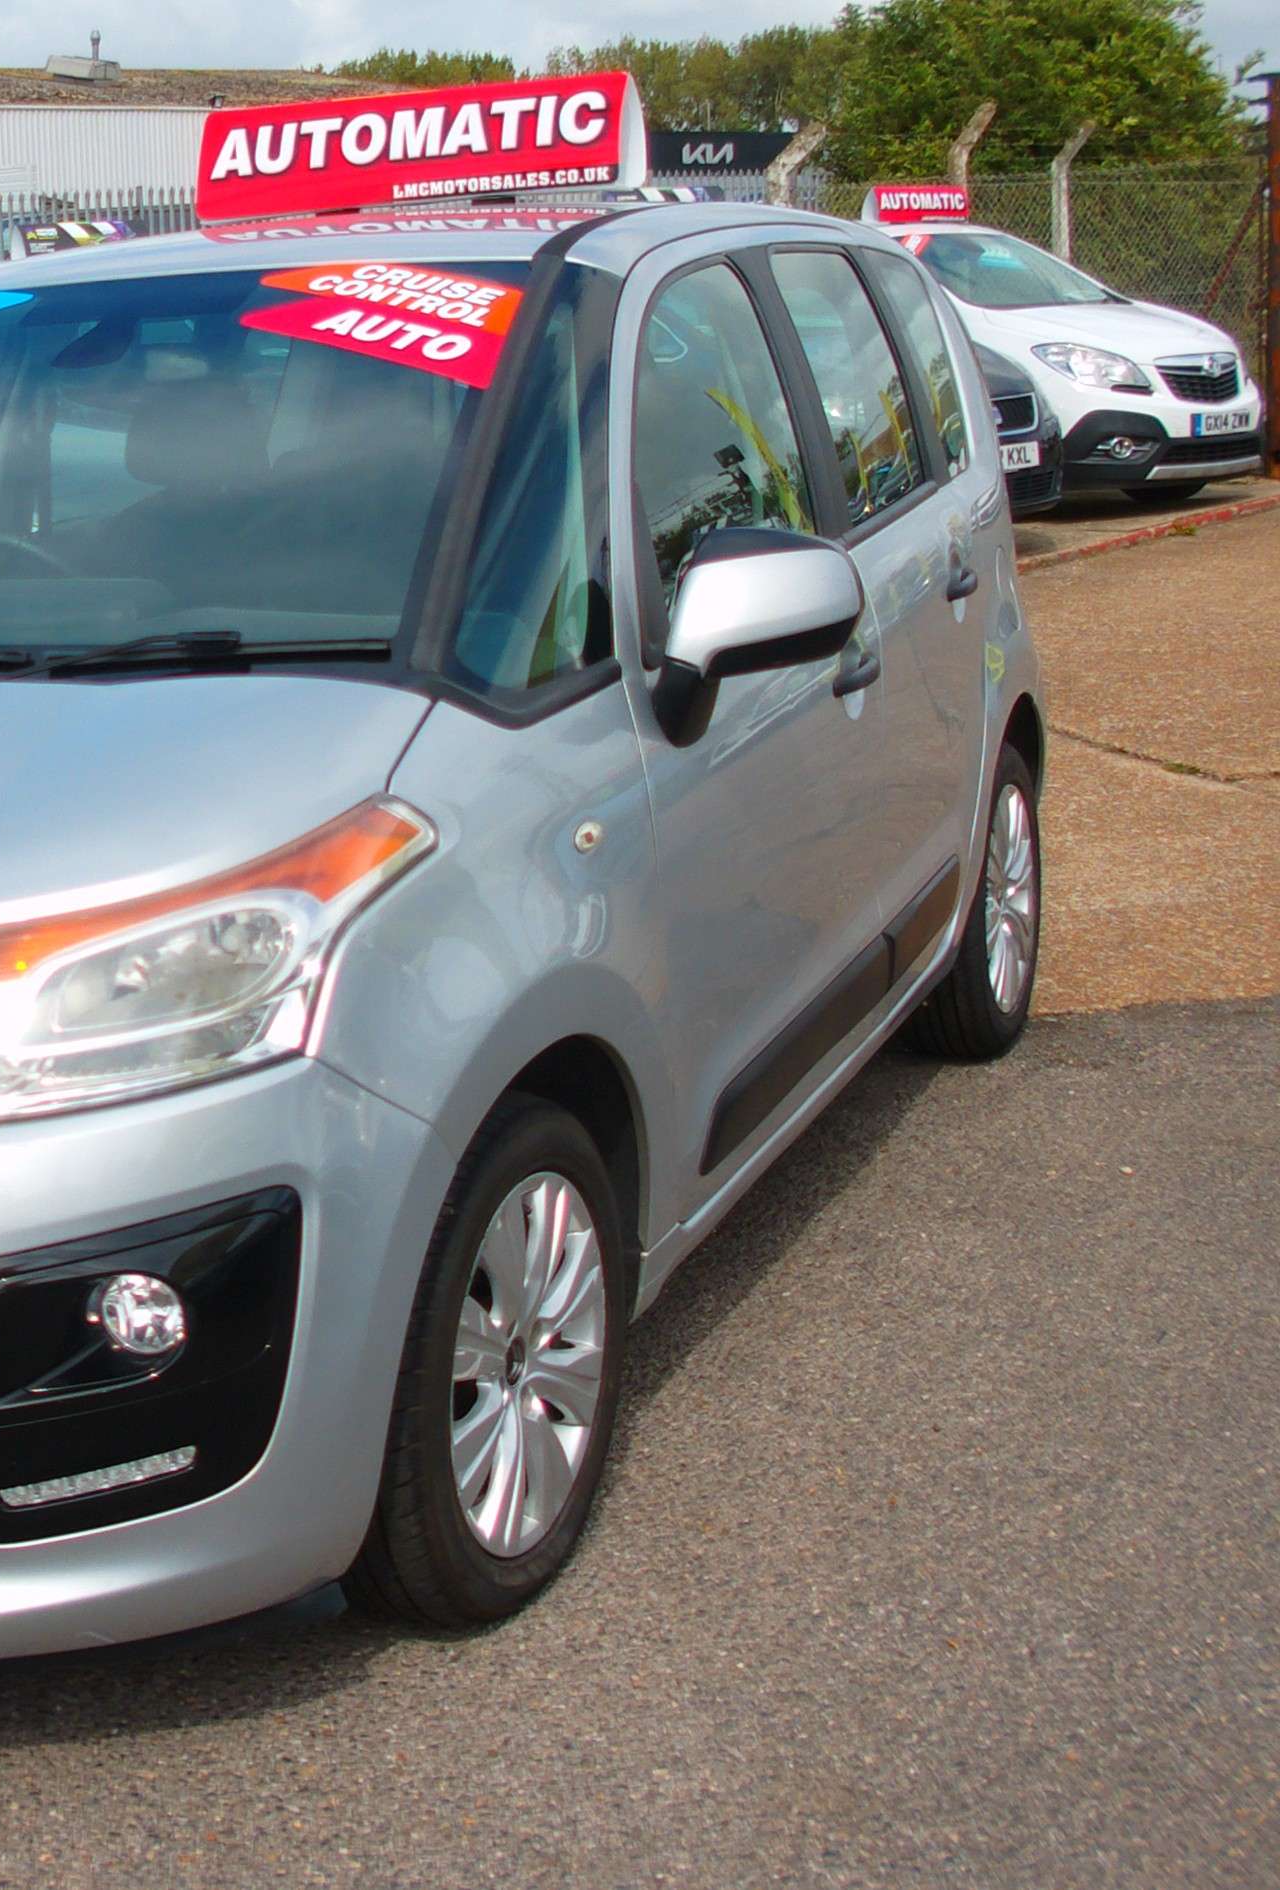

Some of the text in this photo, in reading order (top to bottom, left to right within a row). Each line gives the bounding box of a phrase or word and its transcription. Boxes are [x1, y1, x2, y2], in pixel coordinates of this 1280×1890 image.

[210, 90, 608, 181] AUTOMATIC
[681, 142, 734, 165] KIA
[392, 165, 610, 199] LMCMOTORSALES.CO.UK
[879, 192, 965, 210] AUTOMATIC
[308, 274, 492, 328] CONTROL
[352, 263, 507, 306] CRUISE
[311, 309, 472, 361] AUTO
[1006, 446, 1031, 466] KXL
